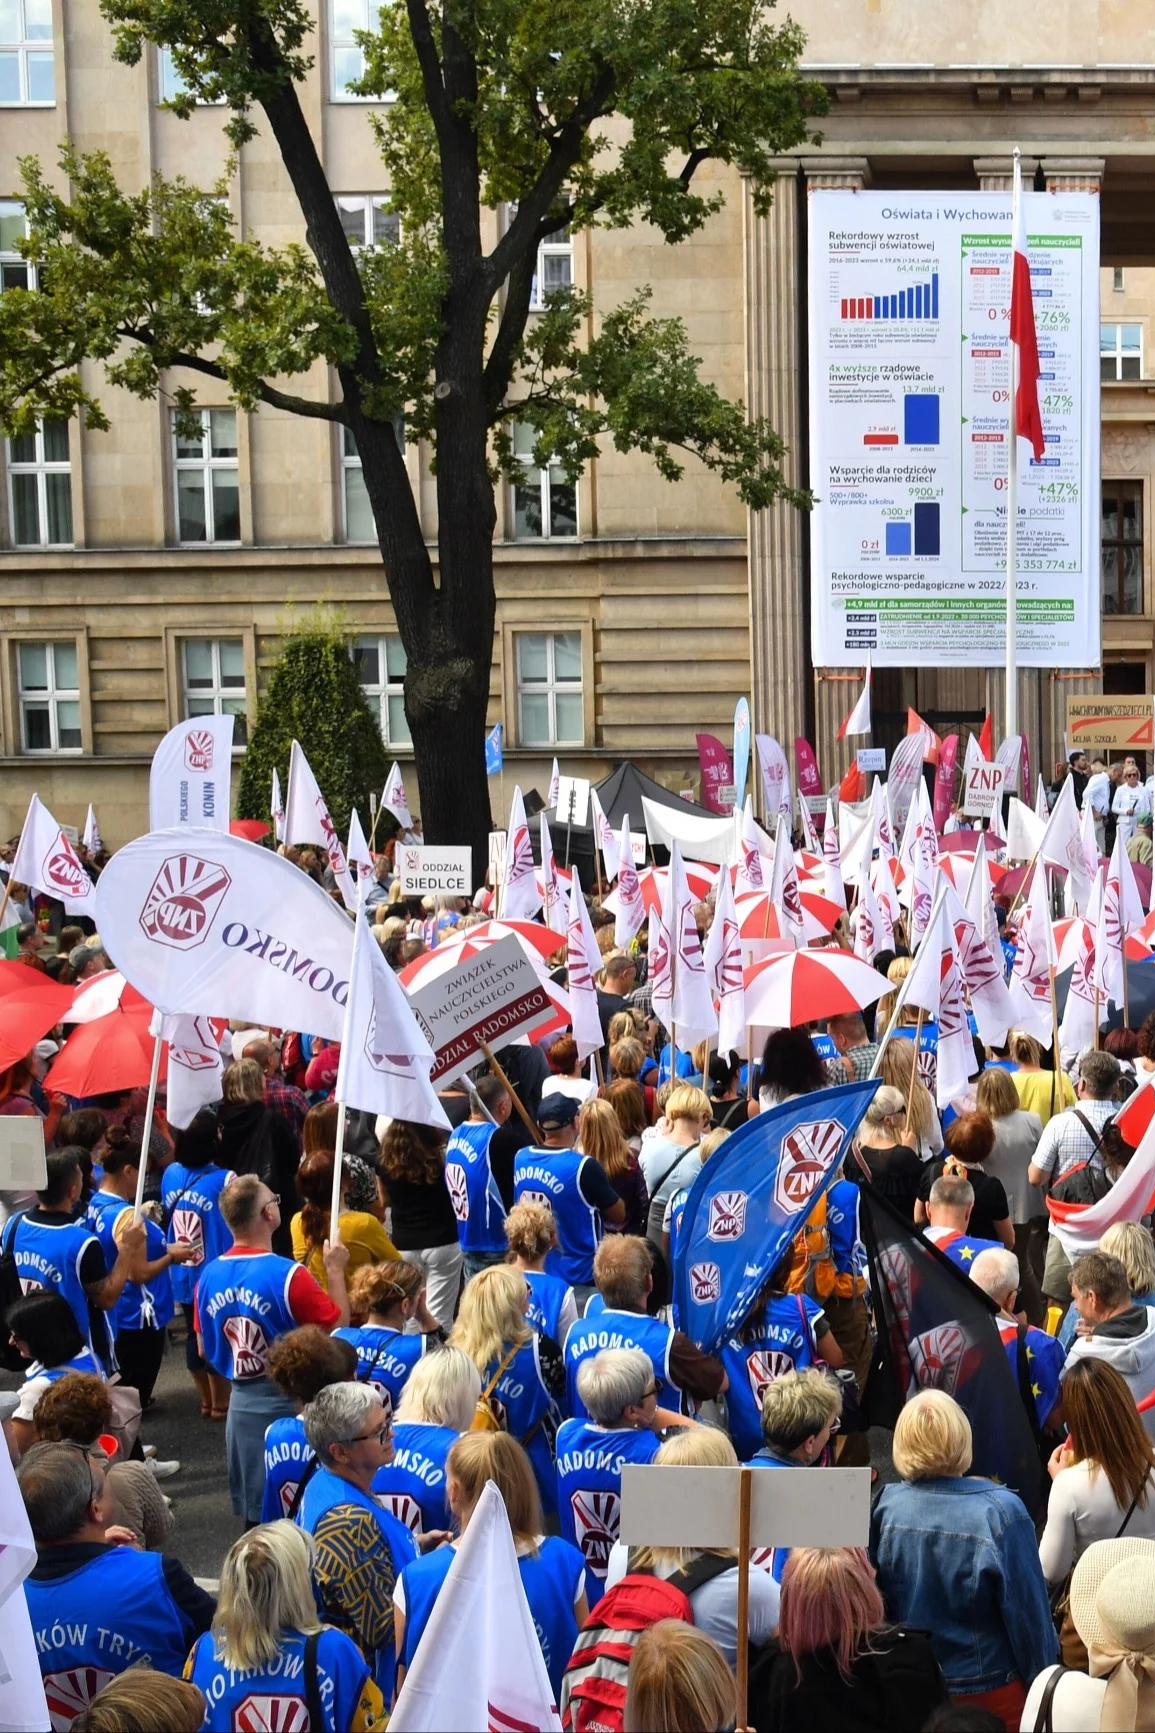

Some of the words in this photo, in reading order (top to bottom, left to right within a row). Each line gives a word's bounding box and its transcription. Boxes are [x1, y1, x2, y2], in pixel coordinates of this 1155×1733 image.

[882, 208, 932, 220] Oświata
[936, 208, 940, 220] i
[943, 208, 1014, 222] Wychowan
[829, 231, 884, 241] Rekordowy
[829, 242, 876, 250] subwencji
[880, 241, 934, 251] oświatowej
[844, 364, 878, 373] wyższe
[880, 364, 920, 374] rządowe
[829, 373, 880, 382] inwestycje
[893, 372, 934, 381] oświacie
[830, 466, 874, 475] Wsparcie
[876, 466, 890, 474] dla
[893, 465, 936, 474] rodziców
[844, 474, 902, 484] wychowanie
[905, 474, 932, 483] dzieci
[908, 488, 933, 496] 9900
[936, 488, 944, 496] zł
[862, 540, 868, 549] 0
[870, 540, 879, 549] zł
[831, 572, 883, 580] Rekordowe
[885, 572, 925, 581] wsparcie
[831, 581, 965, 590] psychologiczno-pedagogiczne
[900, 601, 945, 609] samorządów
[968, 767, 1002, 791] ZNP
[180, 781, 188, 822] POLSKIEGO
[203, 782, 214, 817] KONIN
[968, 801, 994, 809] GÓRNICZ
[50, 855, 83, 882] ZNP
[422, 864, 464, 872] ODDZIAŁ
[405, 877, 465, 889] SIEDLCE
[444, 958, 496, 995] ZWIĄZEK
[429, 959, 527, 1023] NAUCZYCIELSTWA
[454, 981, 515, 1024] POLSKIEGO
[430, 1039, 471, 1076] DZIAŁ
[473, 994, 544, 1042] RADOMSKO
[714, 1218, 736, 1231] ZNP
[16, 1251, 62, 1284] DOMSKO
[206, 1287, 272, 1320] RADOMSKO
[356, 1346, 407, 1379] OMSKO
[267, 1441, 317, 1470] RADOM
[557, 1449, 626, 1478] RADOMS
